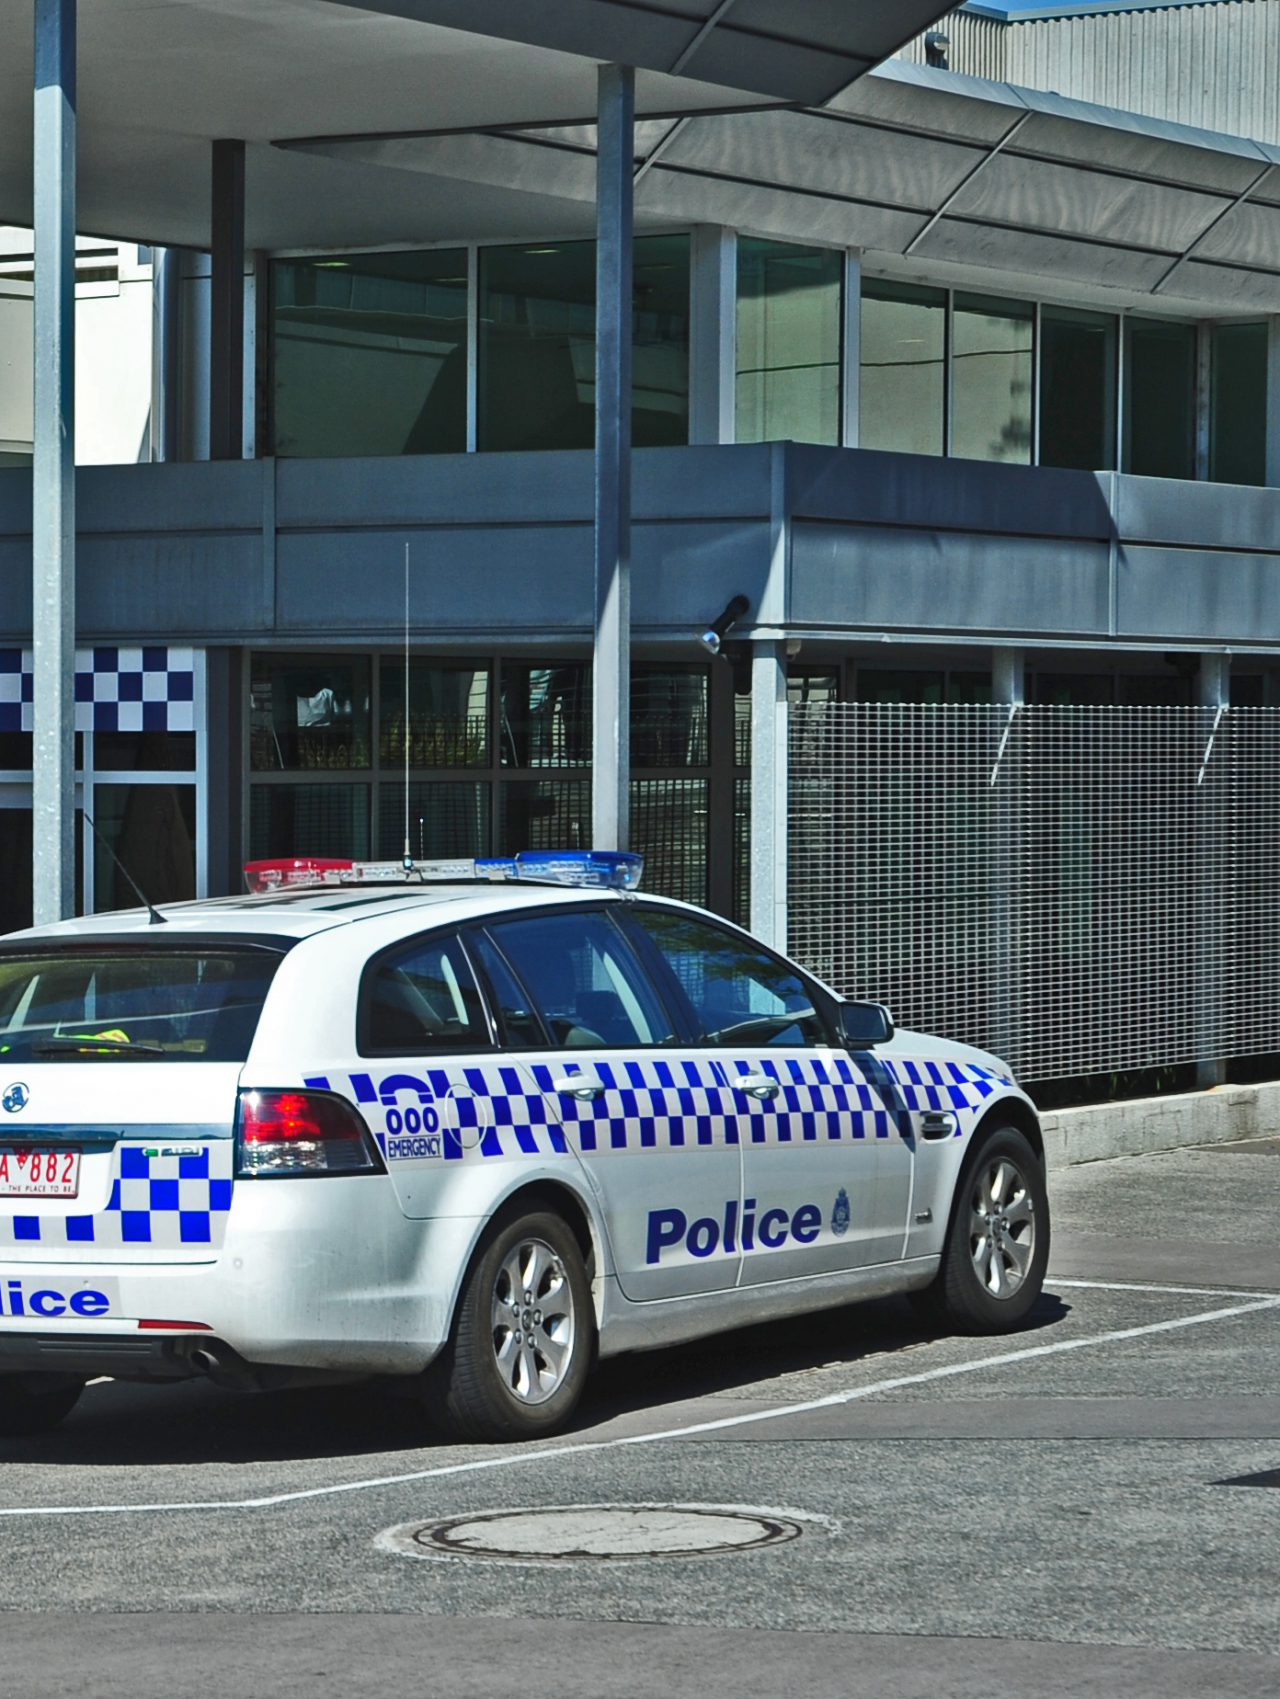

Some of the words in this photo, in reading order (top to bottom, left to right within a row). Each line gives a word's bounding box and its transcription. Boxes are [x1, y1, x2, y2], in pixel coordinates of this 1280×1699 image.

[385, 1106, 439, 1136] 000
[388, 1138, 441, 1158] EMERGENCY
[30, 1152, 75, 1183] 882
[25, 1185, 46, 1193] PLACE
[50, 1185, 59, 1193] TO
[646, 1198, 822, 1265] Police
